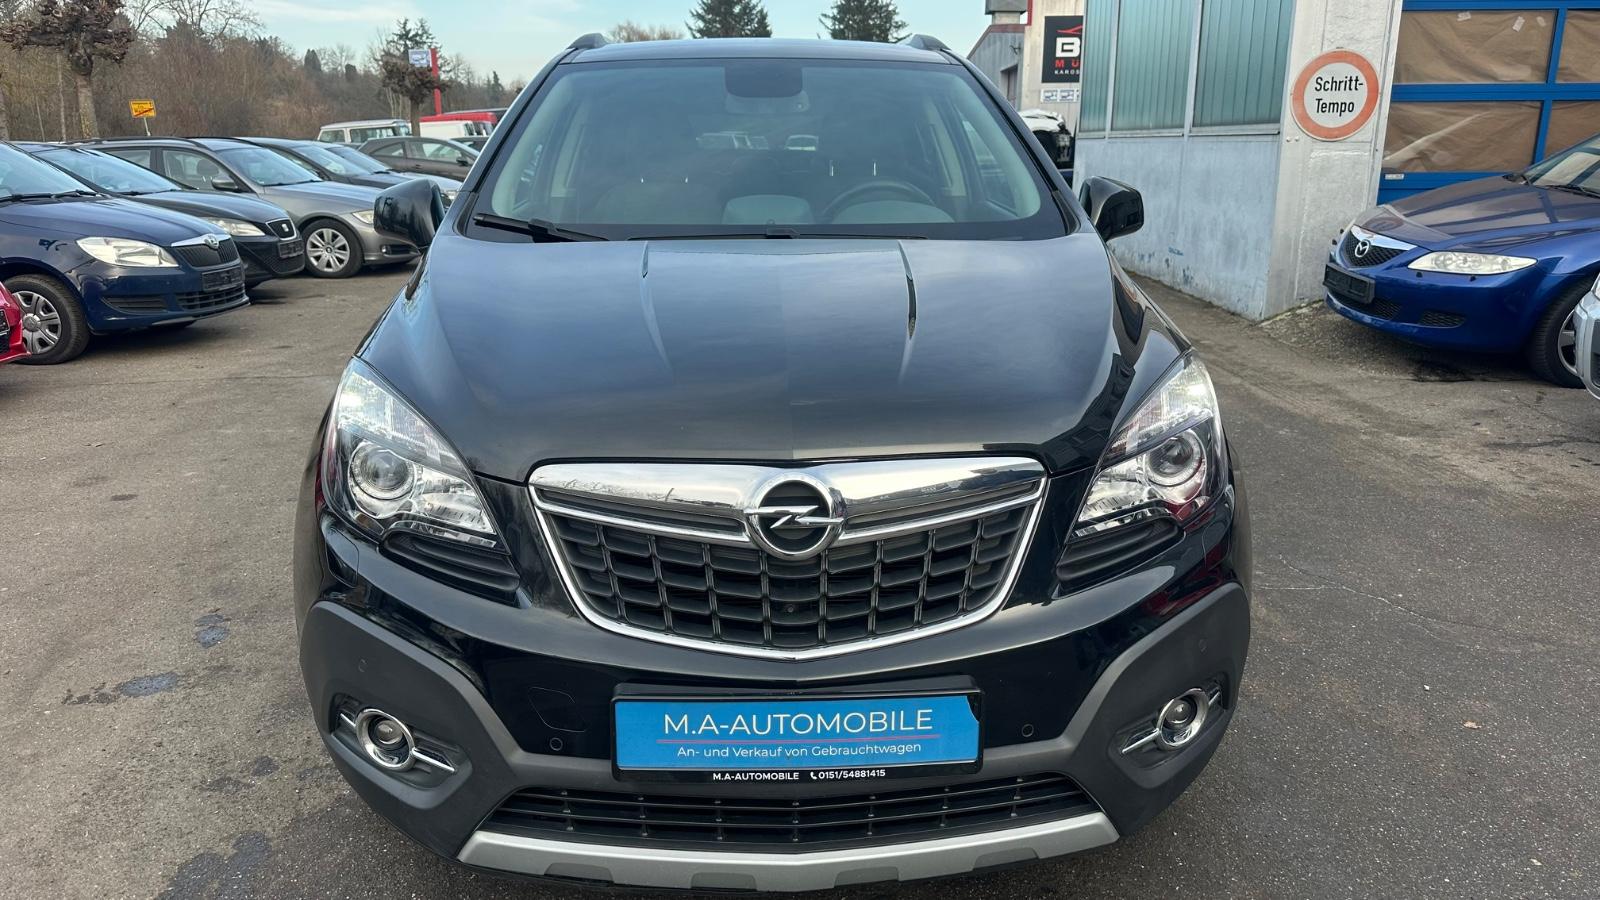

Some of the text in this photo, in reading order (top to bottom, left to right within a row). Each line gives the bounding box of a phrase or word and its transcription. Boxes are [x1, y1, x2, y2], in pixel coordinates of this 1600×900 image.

[1315, 75, 1364, 92] Schritt-
[1315, 98, 1355, 117] Tempo
[664, 709, 933, 735] M.A-AUTOMOBILE
[677, 743, 921, 757] An- und Verkauf von Gebrauchtwagen
[712, 769, 886, 781] M.A-AUTOMOBILE 0151/54881415
